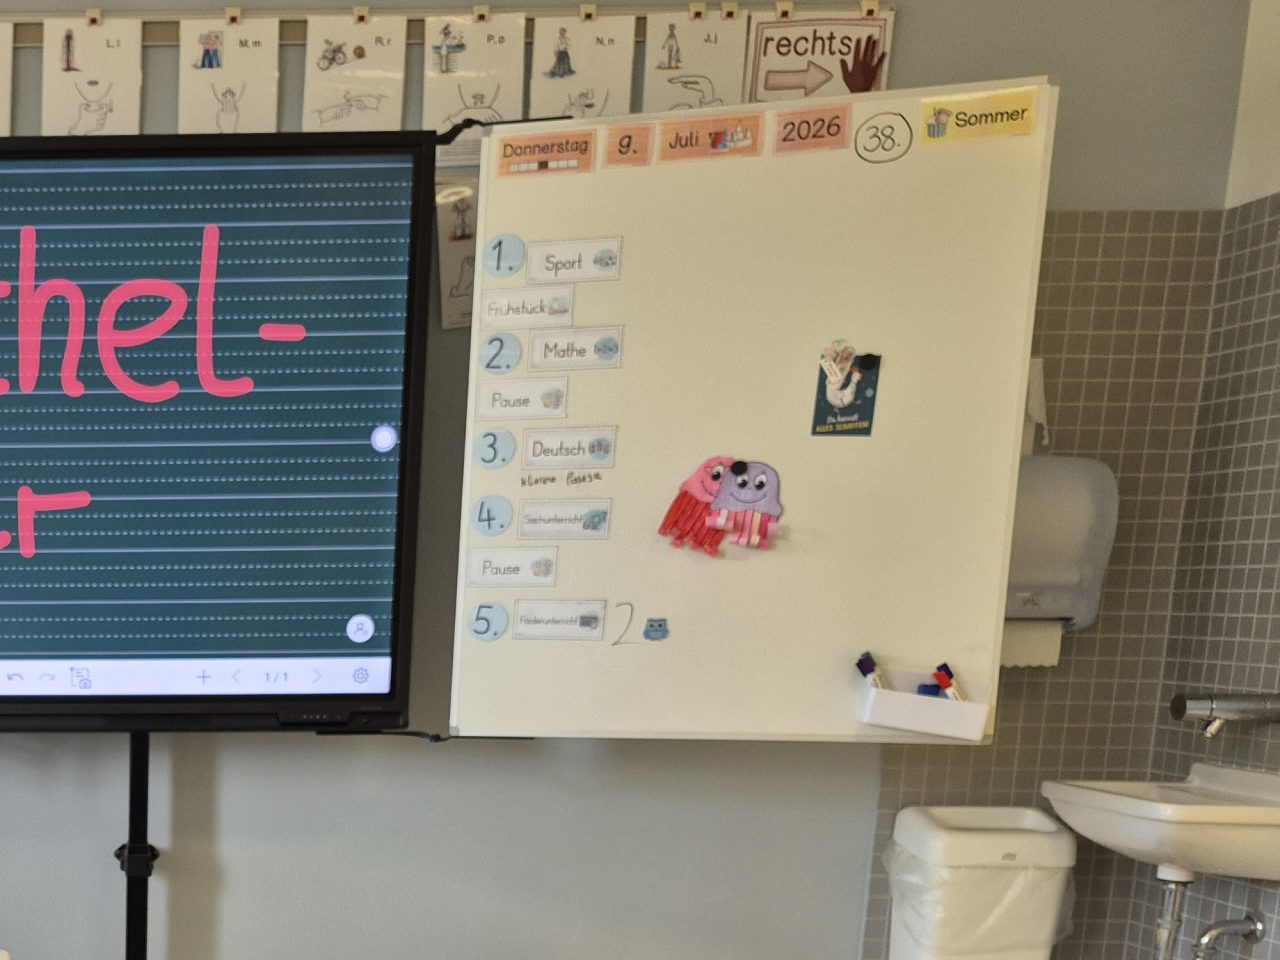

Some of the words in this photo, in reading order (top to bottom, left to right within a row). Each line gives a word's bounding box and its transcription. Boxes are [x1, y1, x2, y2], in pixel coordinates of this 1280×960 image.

[763, 29, 853, 57] rechts
[782, 116, 841, 142] 2026
[955, 107, 1028, 128] Sommer
[503, 139, 589, 158] Donnerstag
[669, 131, 699, 149] Juli
[863, 125, 901, 152] 38.
[491, 238, 514, 272] 1.
[544, 252, 583, 277] Sport
[484, 337, 511, 370] 2.
[543, 342, 587, 359] Mathe
[491, 392, 530, 408] Pause
[480, 432, 507, 464] 3.
[532, 440, 586, 458] Deutsch
[477, 501, 504, 530] 4.
[482, 560, 520, 576] Pause
[472, 604, 499, 636] 5.
